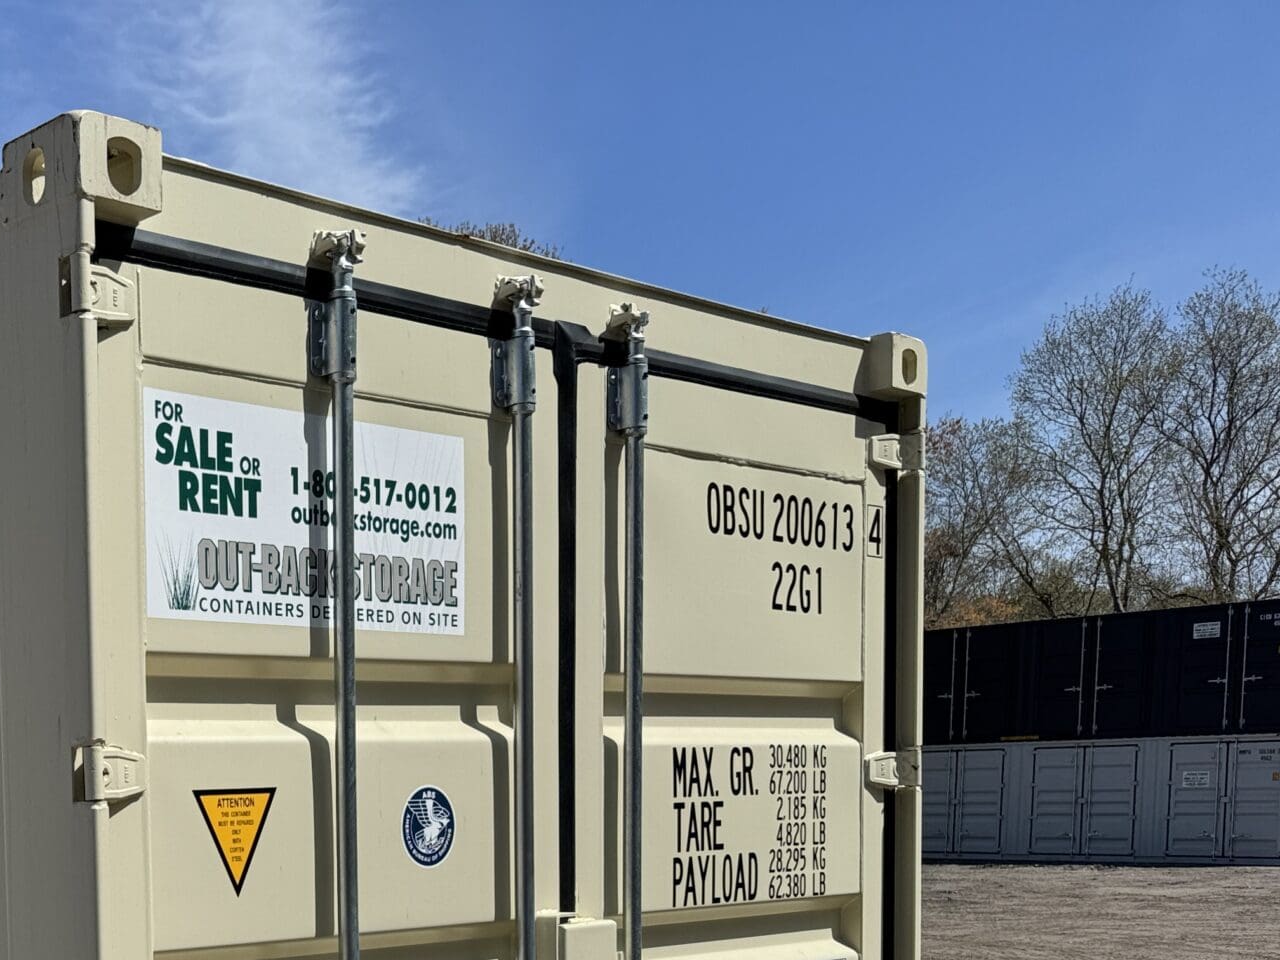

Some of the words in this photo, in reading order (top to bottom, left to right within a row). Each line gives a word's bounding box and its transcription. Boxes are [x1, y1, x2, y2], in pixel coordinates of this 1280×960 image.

[155, 400, 183, 423] FOR
[155, 422, 233, 472] SALE
[240, 456, 261, 477] OR
[178, 470, 262, 518] RENT
[291, 467, 458, 514] 1-80-517-0012
[290, 500, 458, 543] outbkstorage.com
[706, 482, 765, 540] OBSU
[772, 493, 854, 552] 200613
[868, 508, 882, 555] 4
[198, 538, 336, 598] OUT-BACK
[771, 561, 823, 614] 22G1
[198, 597, 304, 618] CONTAINERS
[312, 605, 395, 624] DEERED
[401, 610, 422, 626] ON
[428, 612, 459, 628] SITE
[673, 746, 719, 798] MAX.
[730, 746, 759, 796] GR.
[813, 744, 827, 768] KG
[422, 790, 436, 799] ABS
[812, 770, 827, 794] LB
[217, 797, 255, 808] ATTENTION
[812, 796, 826, 819] KG
[673, 801, 724, 853] TARE
[812, 821, 826, 845] LB
[812, 847, 826, 871] KG
[672, 852, 758, 908] PAYLOAD
[812, 872, 826, 896] LB
